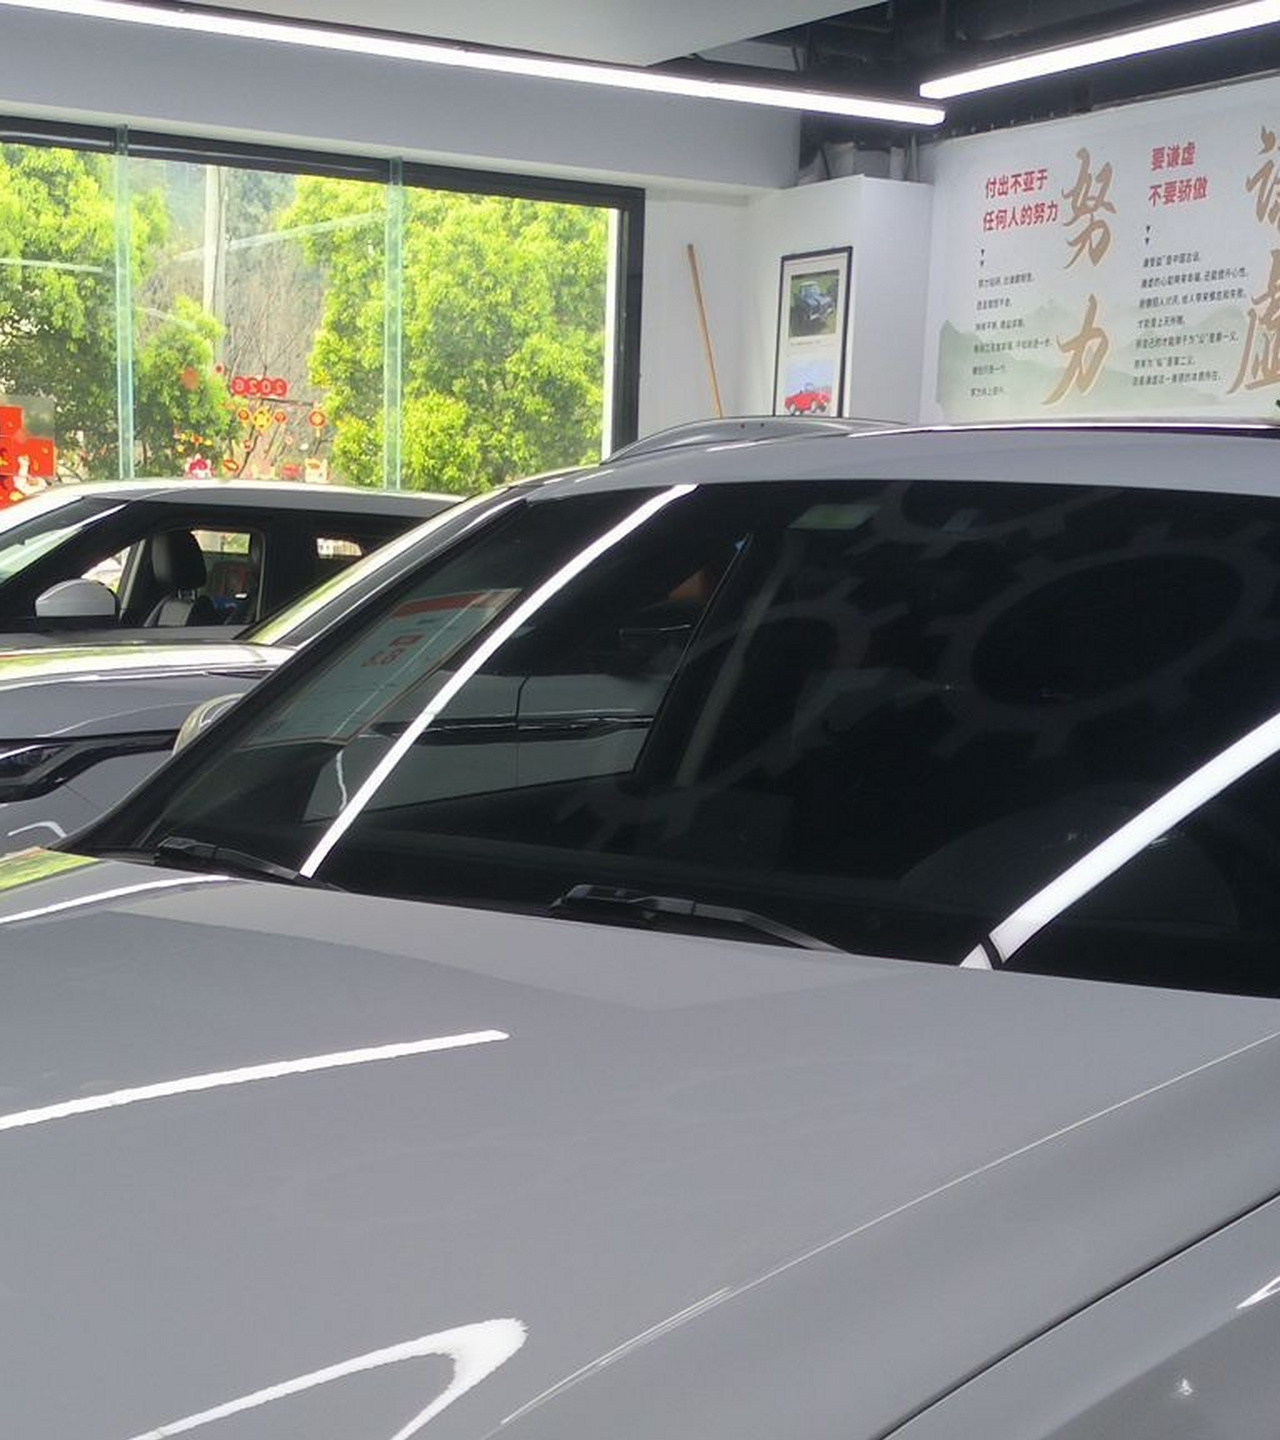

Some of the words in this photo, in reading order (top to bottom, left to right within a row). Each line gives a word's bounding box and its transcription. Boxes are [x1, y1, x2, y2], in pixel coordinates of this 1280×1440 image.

[1151, 141, 1196, 171] 要谦虚
[985, 169, 1049, 199] 付出不亚于
[1148, 176, 1209, 207] 不要骄傲
[982, 200, 1060, 232] 任何人的努力
